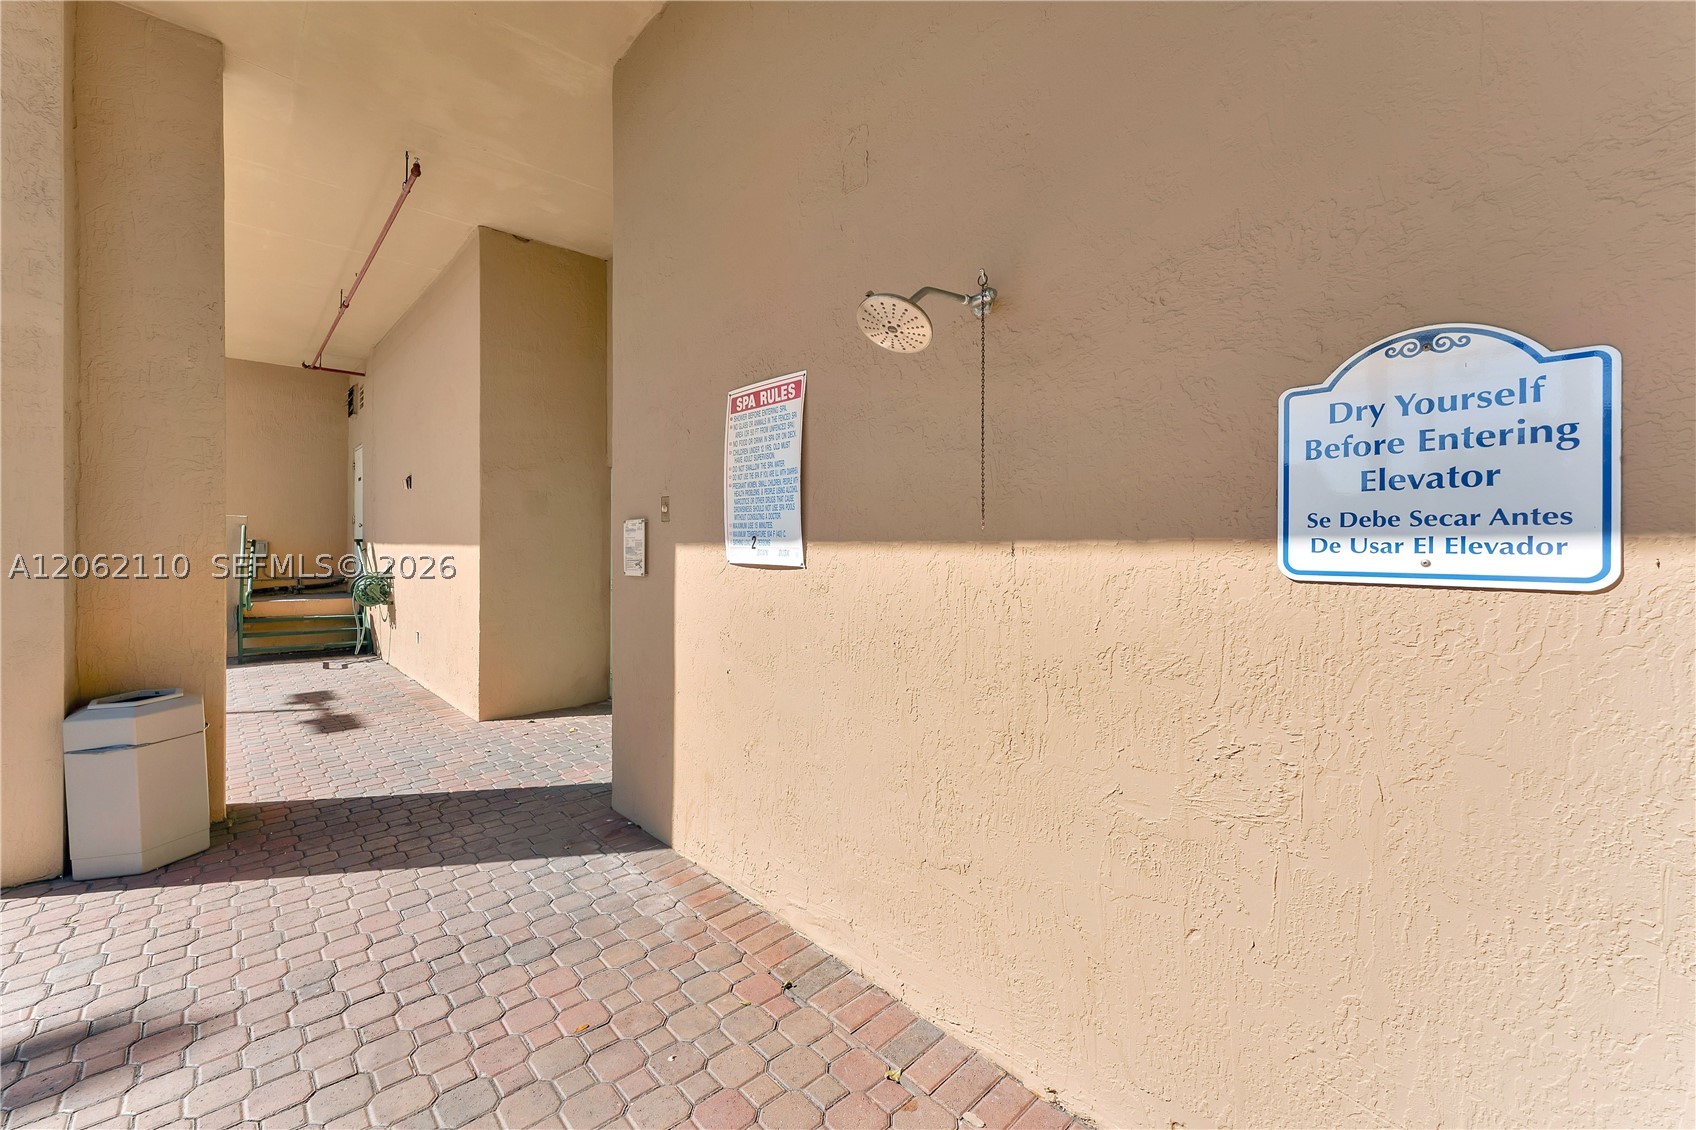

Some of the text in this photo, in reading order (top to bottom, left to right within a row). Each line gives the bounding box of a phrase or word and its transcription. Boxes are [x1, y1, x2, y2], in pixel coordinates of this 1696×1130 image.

[736, 383, 796, 411] SPA RULES
[1329, 374, 1547, 427] Dry Yourself
[734, 414, 747, 422] SHOWER
[748, 411, 761, 419] BEFORE
[762, 406, 778, 416] ENTERING
[754, 418, 766, 426] ANIMALS
[778, 413, 790, 421] FENCED
[769, 422, 786, 432] UNFENCED
[754, 436, 763, 444] DRINK
[1305, 418, 1580, 461] Before Entering
[733, 447, 748, 456] CHILDREN
[749, 446, 760, 454] UNDER
[781, 441, 790, 449] MUST
[745, 463, 759, 471] SWALLOW
[1360, 466, 1501, 492] Elevator
[764, 487, 775, 495] PEOPLE
[734, 497, 750, 505] NARCOTICS
[785, 495, 794, 503] CAUSE
[786, 503, 795, 511] POOLS
[1307, 507, 1573, 529] Se Debe Secar Antes
[751, 536, 756, 549] 2
[1311, 535, 1568, 555] De Usar El Elevador
